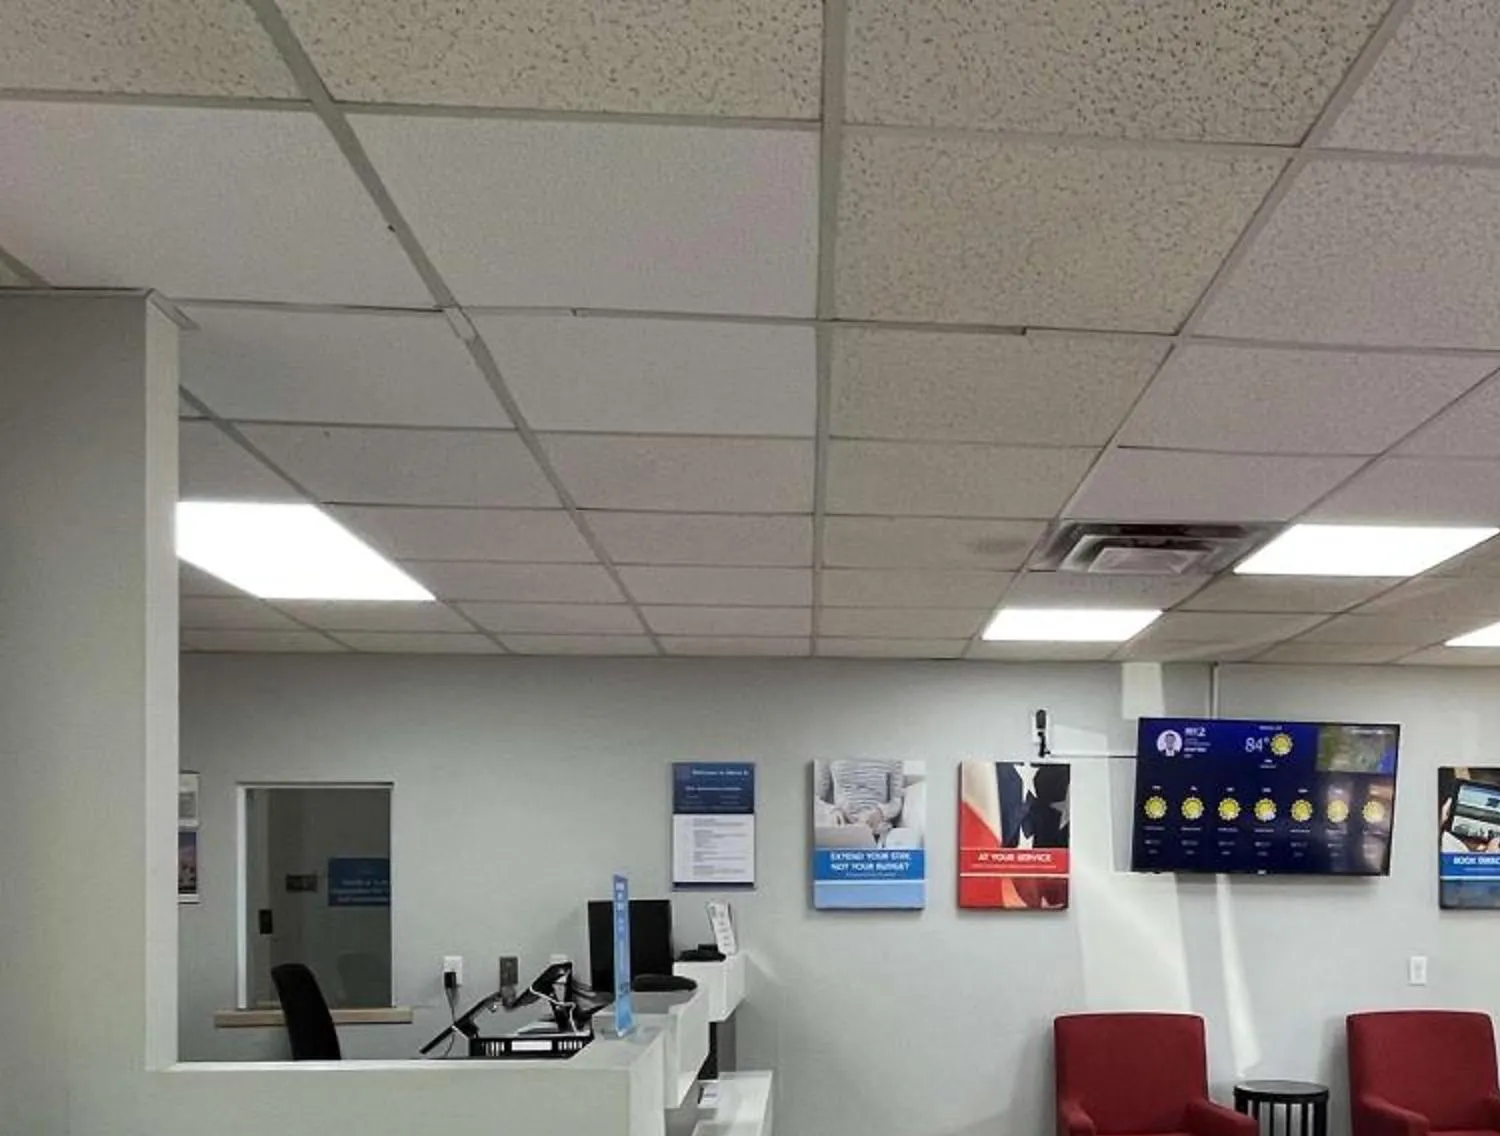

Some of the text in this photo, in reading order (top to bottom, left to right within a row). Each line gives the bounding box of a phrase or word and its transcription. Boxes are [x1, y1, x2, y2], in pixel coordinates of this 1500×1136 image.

[867, 852, 889, 861] YOUR
[978, 853, 1052, 861] AT YOUR SERVICE
[1453, 856, 1477, 865] BOOK
[831, 863, 849, 871] NOT
[851, 863, 874, 871] YOUR
